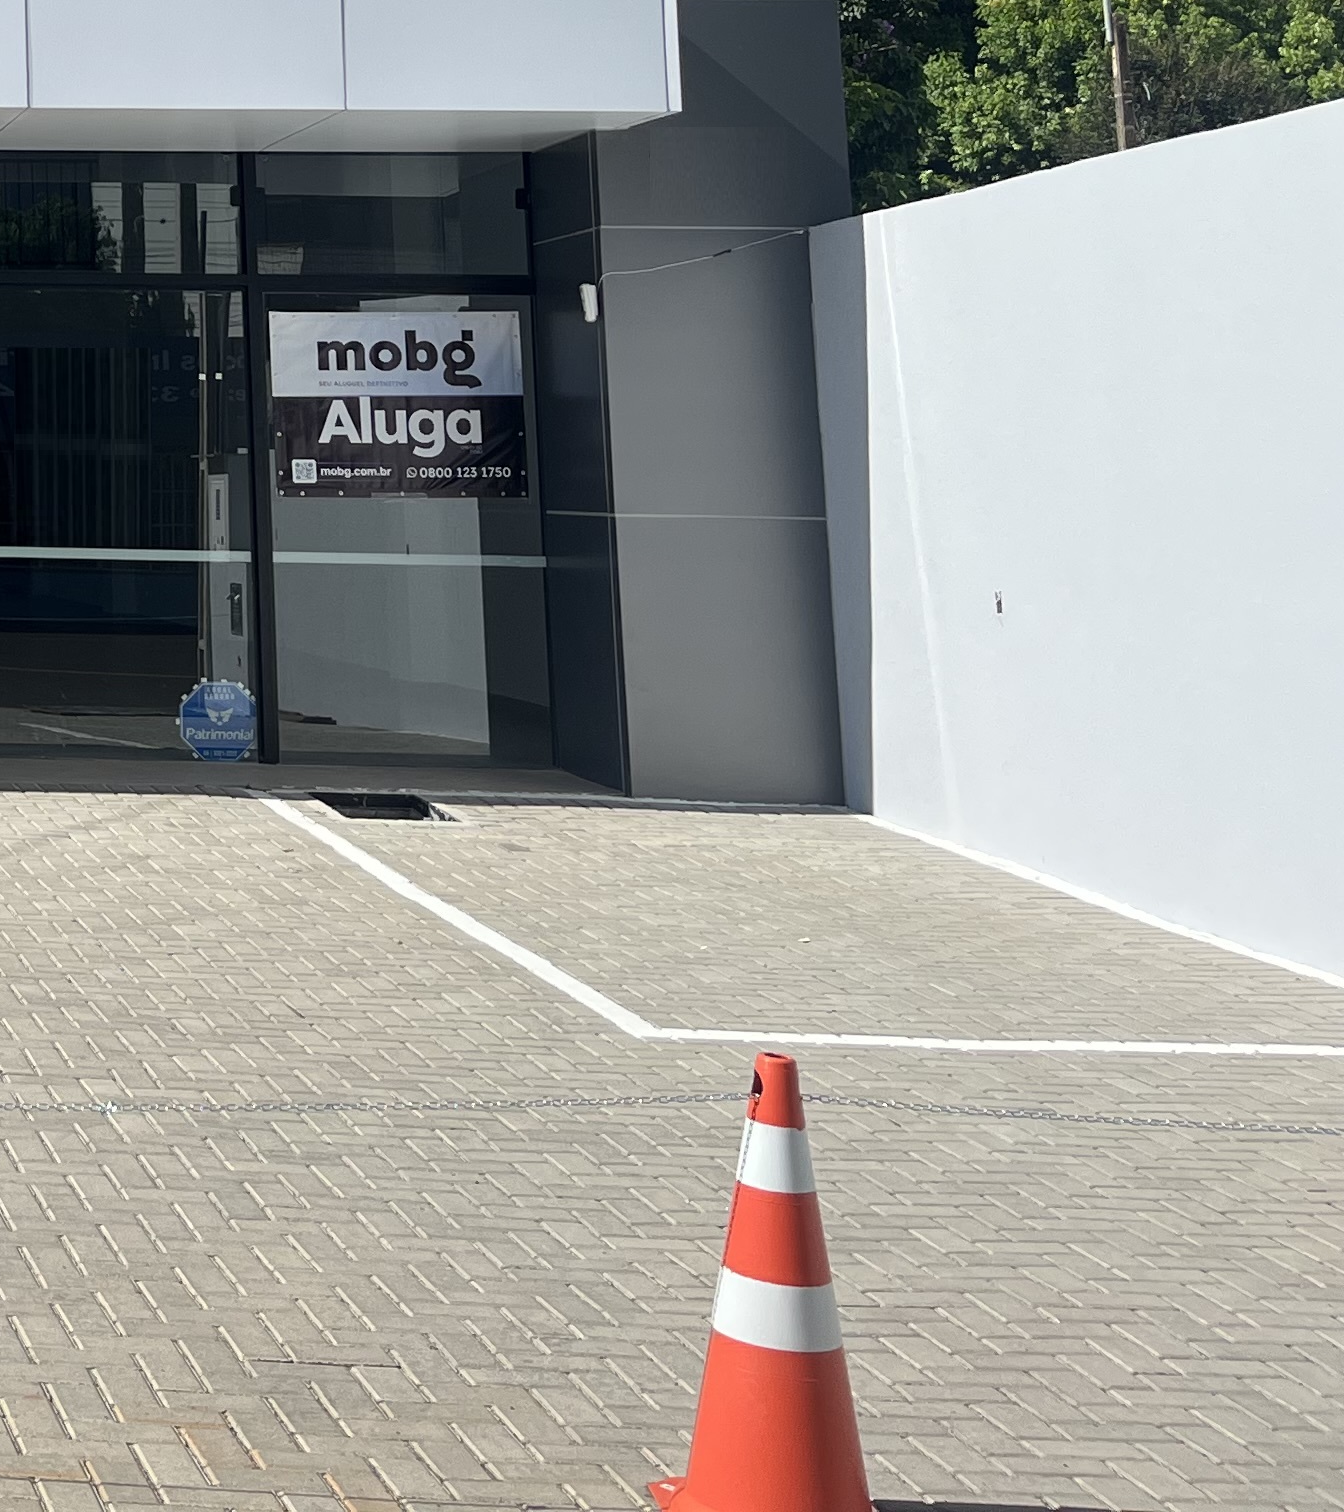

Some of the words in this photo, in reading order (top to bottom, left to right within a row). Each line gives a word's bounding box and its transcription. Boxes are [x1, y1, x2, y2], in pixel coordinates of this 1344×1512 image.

[317, 330, 482, 389] mobg
[318, 396, 483, 458] Aluga
[320, 465, 392, 479] mobg.com.br
[419, 466, 453, 479] 0800
[456, 466, 478, 479] 123
[481, 466, 511, 478] 1750
[185, 727, 254, 741] Patrimonial
